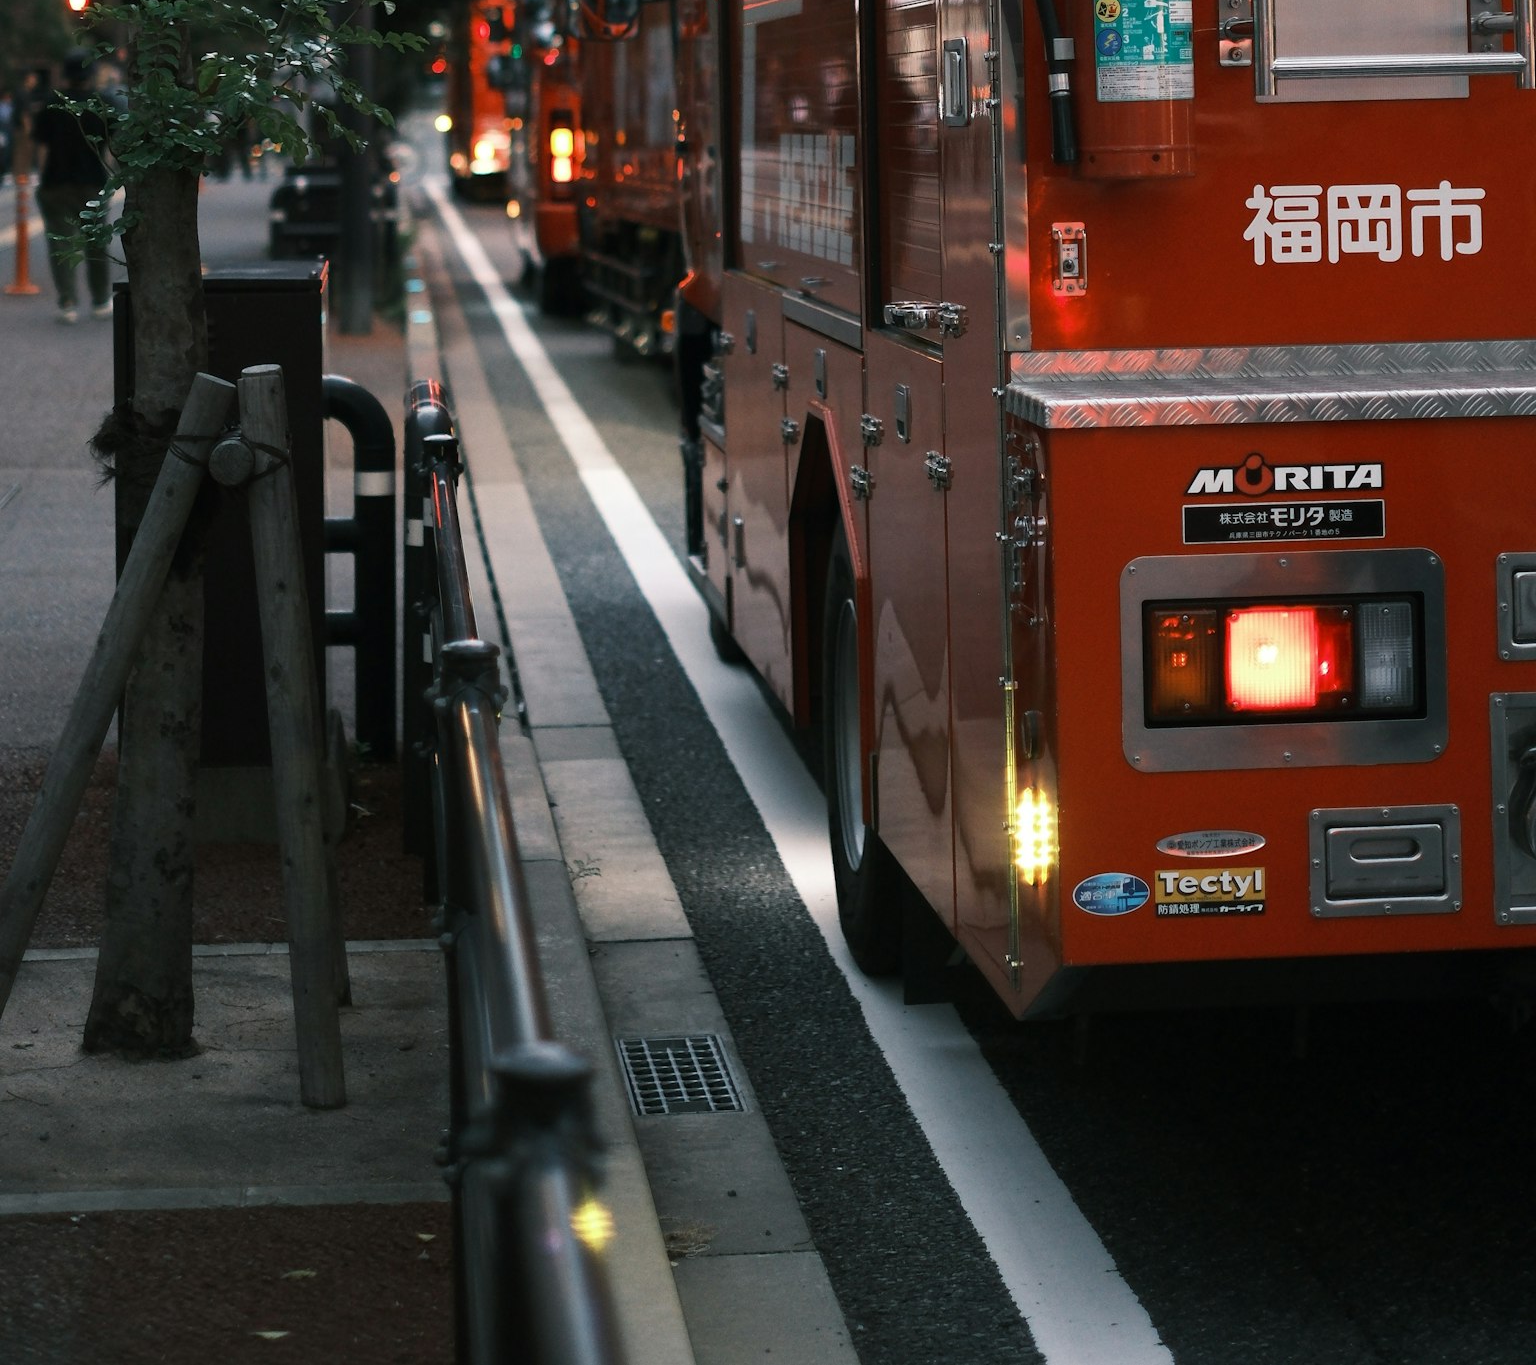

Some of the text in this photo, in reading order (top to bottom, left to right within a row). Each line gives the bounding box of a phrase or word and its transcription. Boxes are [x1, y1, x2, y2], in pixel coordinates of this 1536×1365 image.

[1122, 8, 1129, 17] 2
[1122, 35, 1131, 44] 3
[1242, 179, 1487, 267] 福岡市
[1186, 454, 1384, 496] MORITA
[1158, 869, 1263, 899] Tectyl
